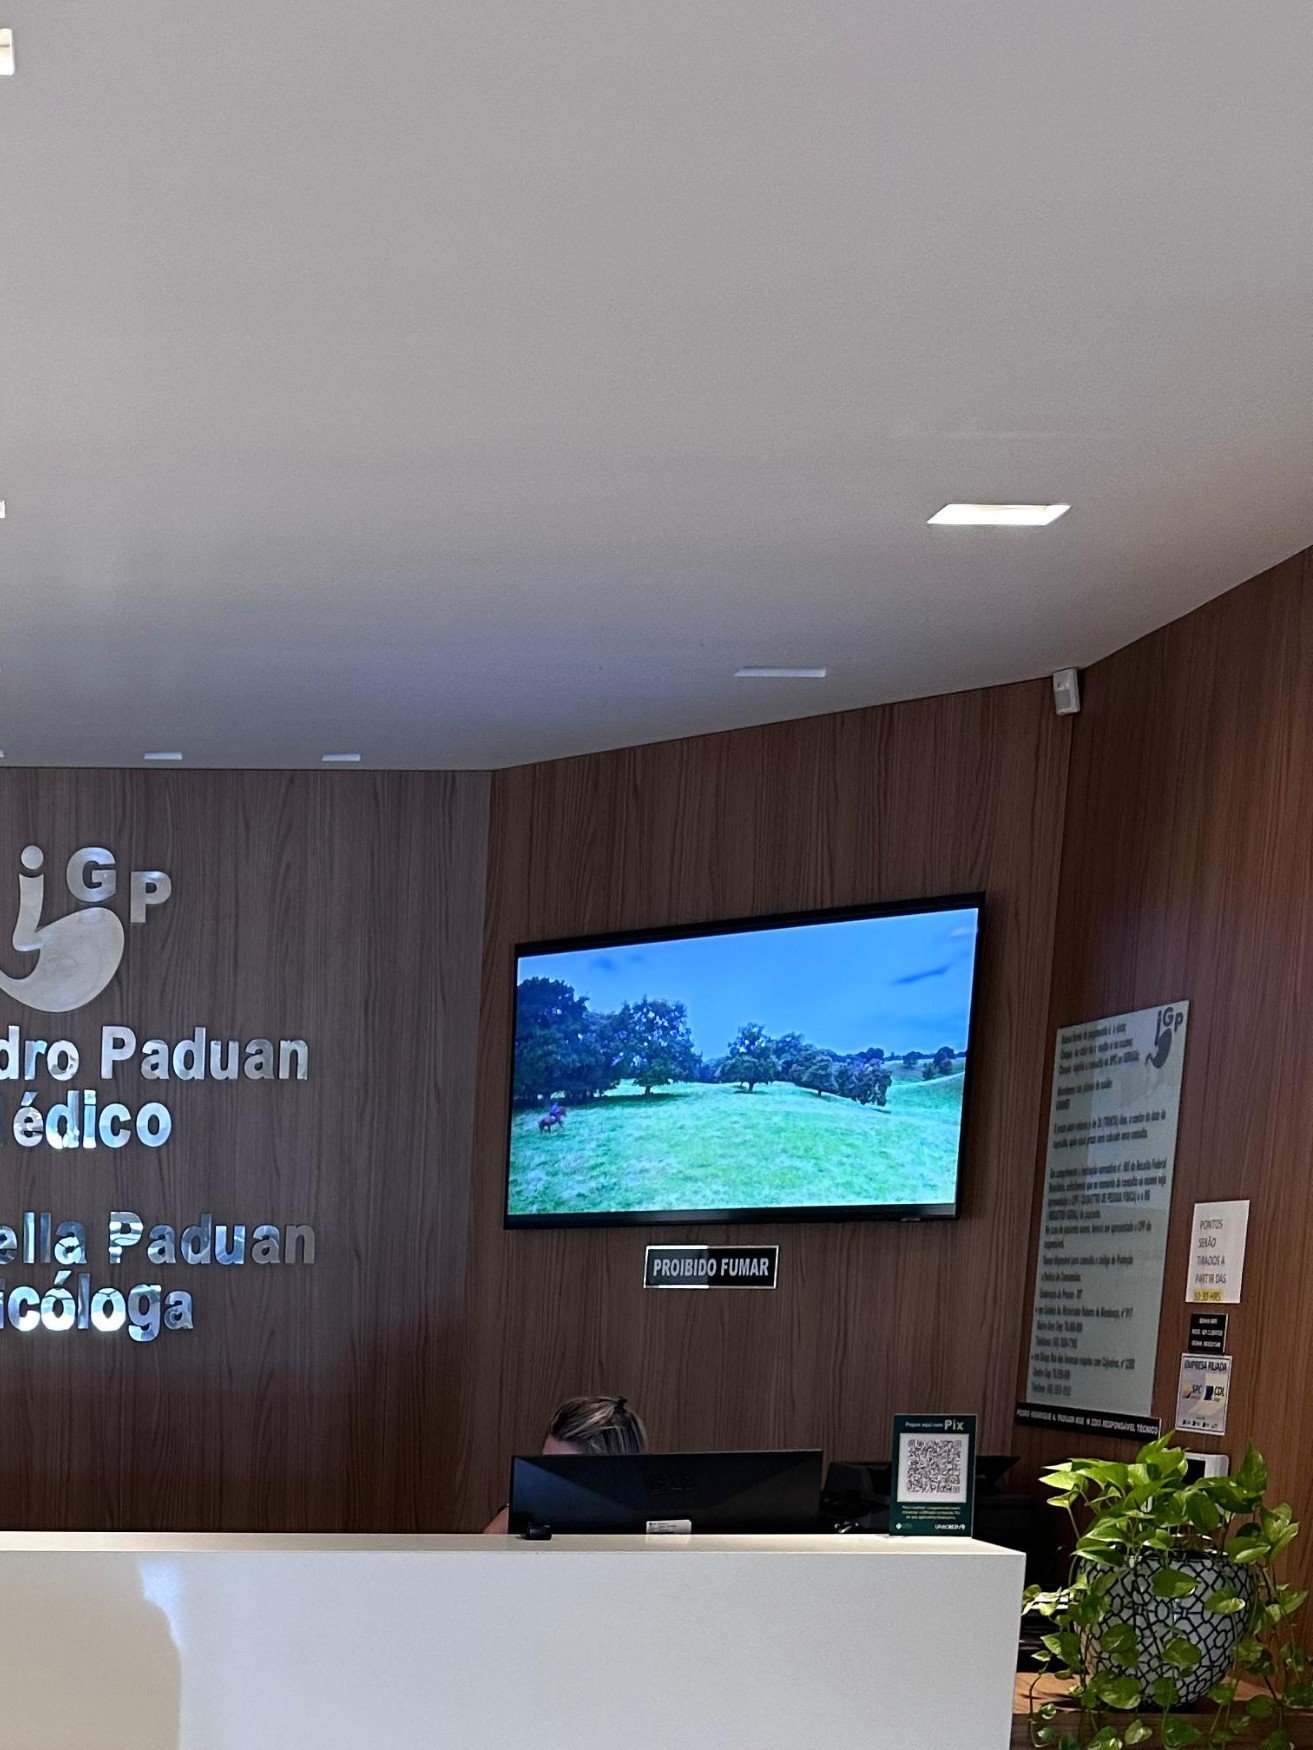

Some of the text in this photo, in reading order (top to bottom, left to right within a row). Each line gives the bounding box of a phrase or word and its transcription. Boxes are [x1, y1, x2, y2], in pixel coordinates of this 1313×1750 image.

[100, 1025, 309, 1081] Paduan
[109, 1210, 316, 1265] Paduan
[653, 1257, 769, 1277] PROIBIDO FUMAR
[944, 1419, 964, 1431] Pix
